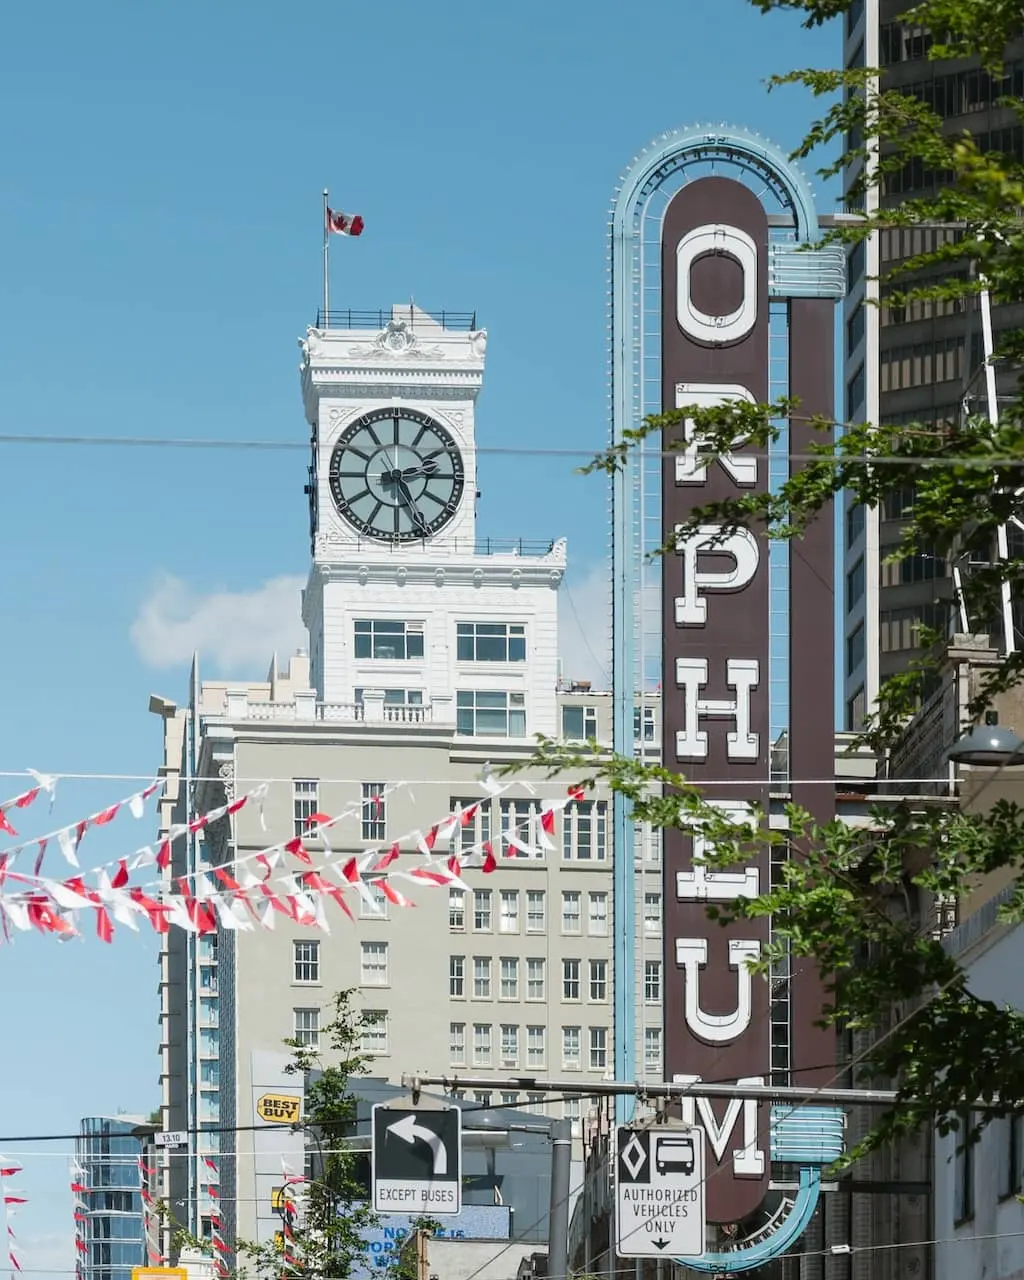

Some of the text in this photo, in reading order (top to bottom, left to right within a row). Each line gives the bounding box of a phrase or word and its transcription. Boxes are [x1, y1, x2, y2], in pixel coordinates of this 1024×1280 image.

[674, 224, 764, 1175] ORPHEUM
[263, 1099, 298, 1110] BEST
[263, 1108, 294, 1119] BUY
[379, 1188, 454, 1202] EXCEPT BUSES
[624, 1189, 698, 1202] AUTHORIZED
[633, 1204, 688, 1217] VEHICLES
[645, 1221, 676, 1233] ONLY
